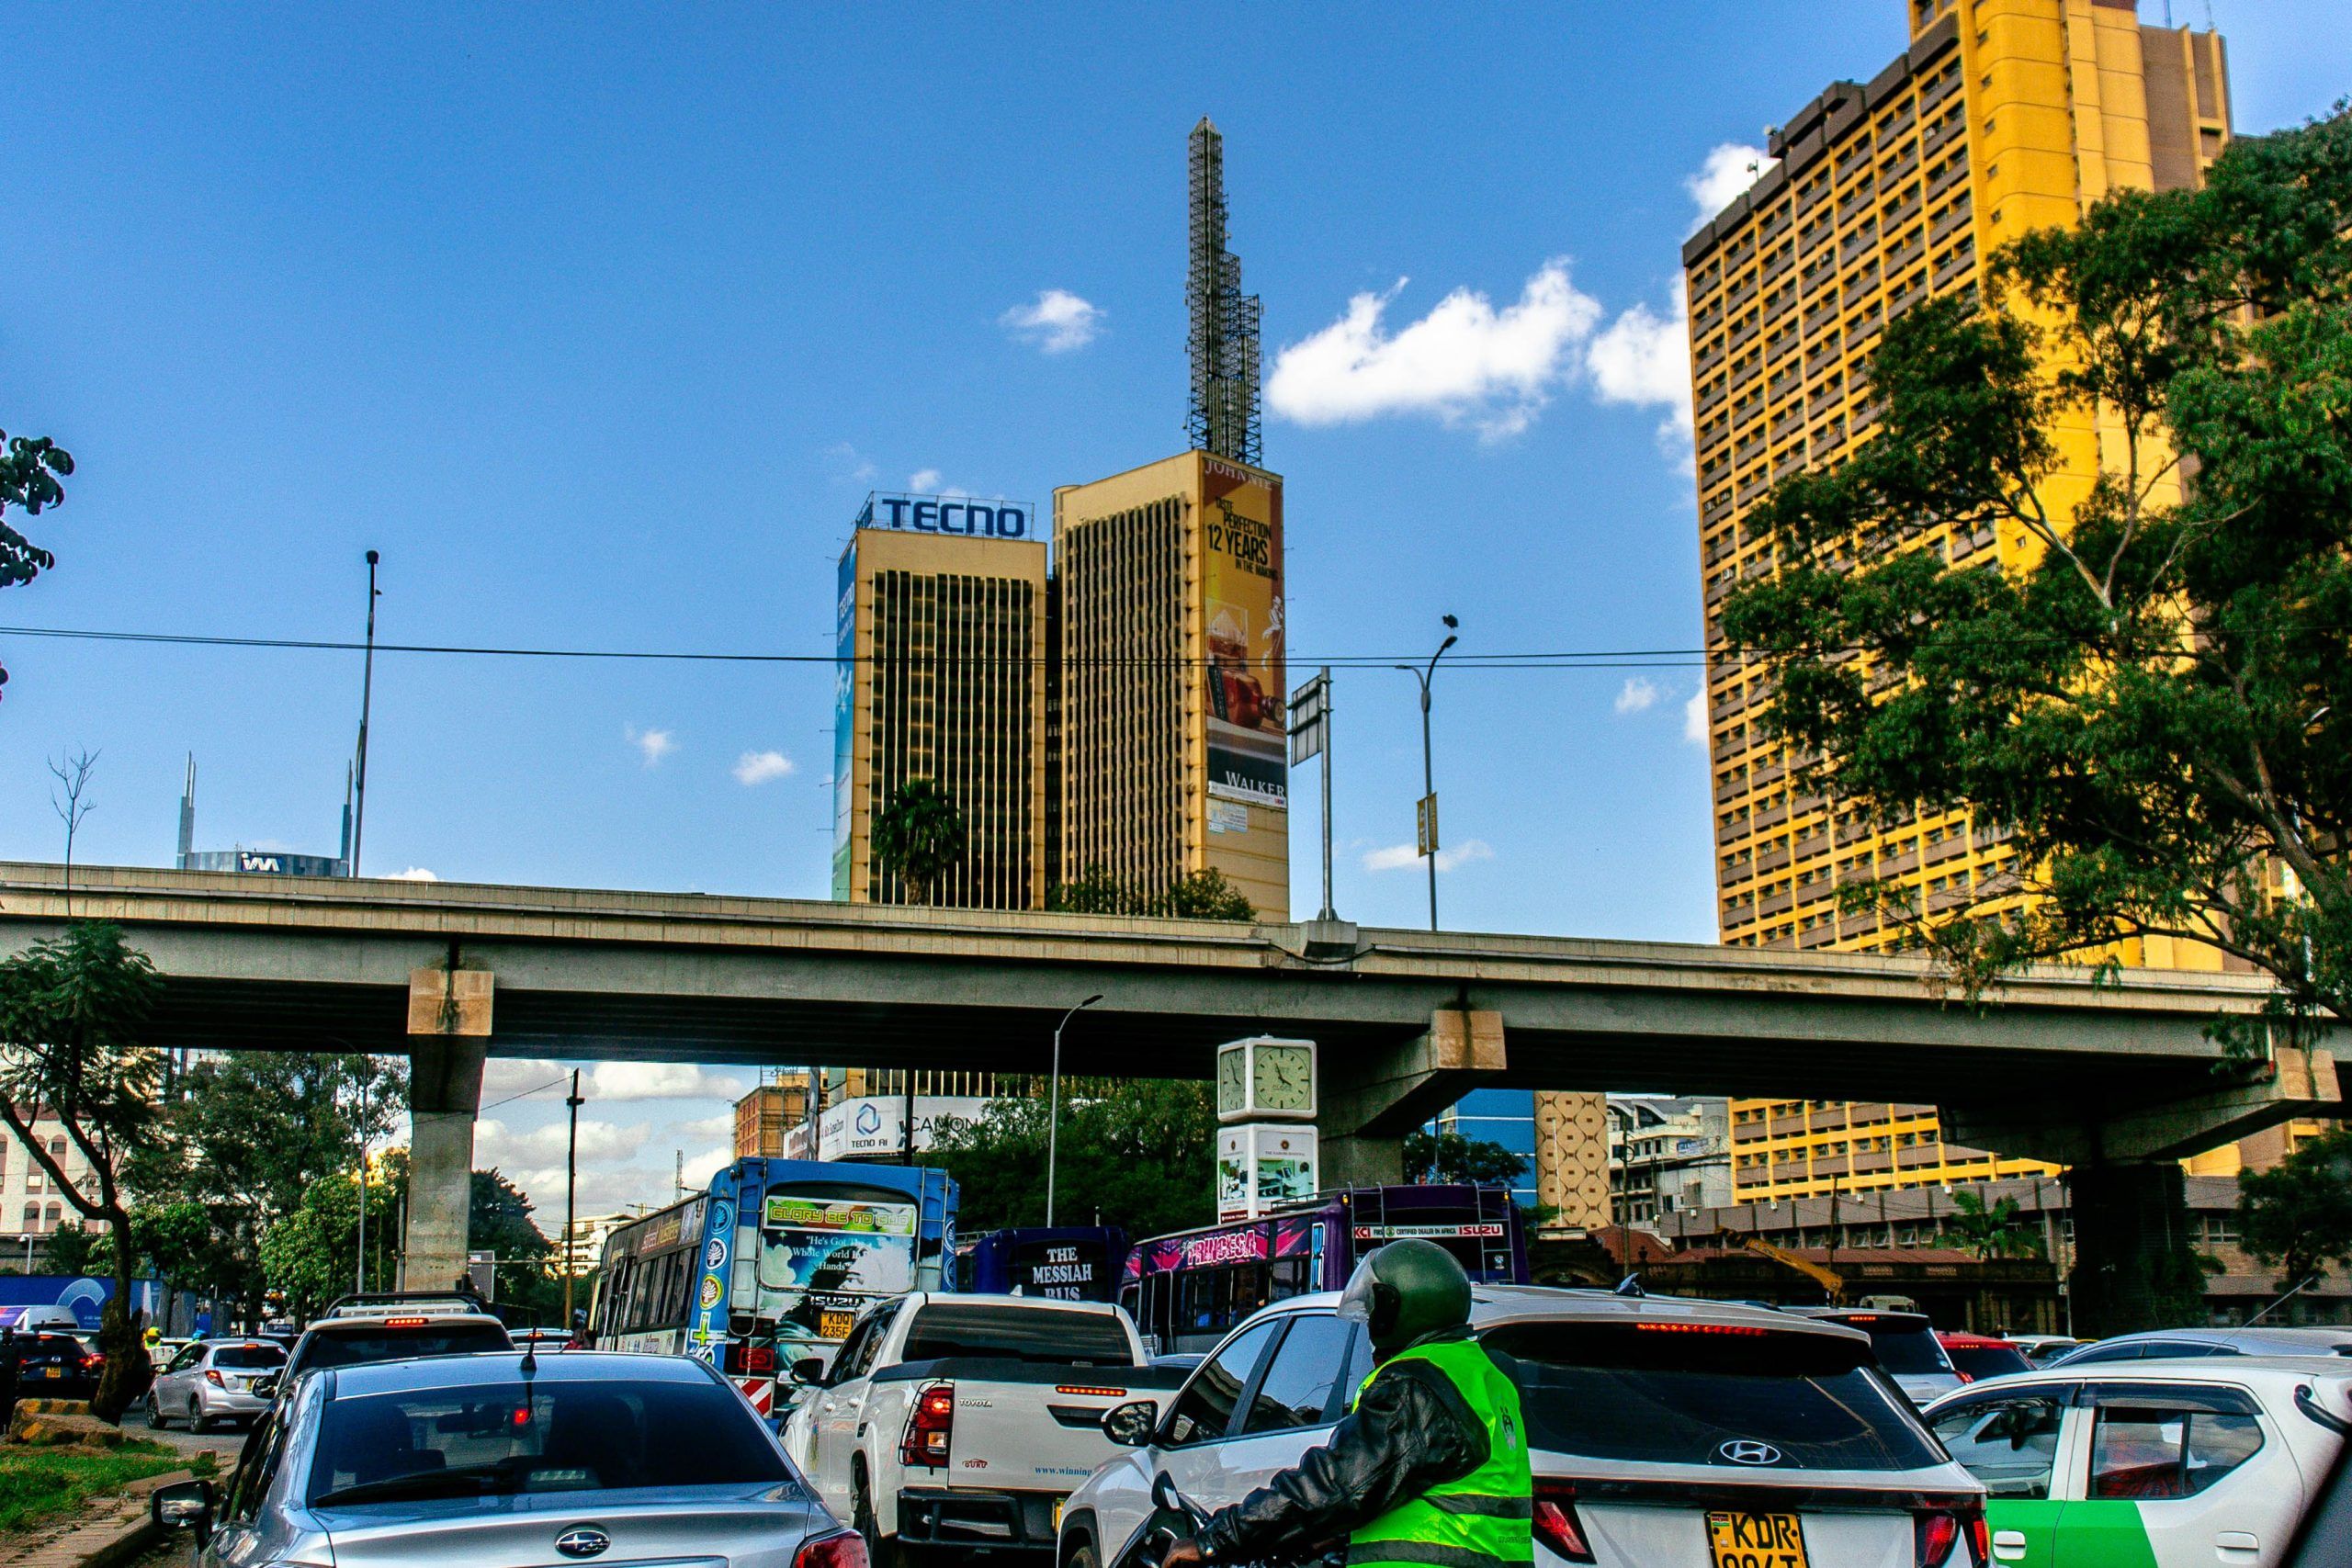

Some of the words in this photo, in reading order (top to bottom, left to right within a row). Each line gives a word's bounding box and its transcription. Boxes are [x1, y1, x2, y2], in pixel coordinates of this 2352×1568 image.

[1204, 461, 1272, 491] JOHNNIE
[882, 498, 1025, 537] TECNO
[1224, 511, 1272, 540] PERFECTION
[1207, 523, 1222, 551] 12
[1225, 528, 1268, 566] YEARS
[1243, 561, 1254, 574] THE
[1226, 771, 1285, 797] WALKER
[911, 1116, 980, 1133] CAMON
[851, 1140, 876, 1148] TECNO
[771, 1206, 824, 1222] GLORY
[825, 1210, 848, 1224] BE
[851, 1212, 874, 1225] TO
[1354, 1226, 1371, 1238] KCI
[1459, 1224, 1500, 1235] ISUZU
[830, 1236, 846, 1247] Got
[1187, 1229, 1256, 1266] PRINCESA
[792, 1247, 820, 1258] Whole
[823, 1248, 850, 1259] World
[1046, 1247, 1078, 1263] THE
[1033, 1264, 1092, 1284] MESSIAH
[810, 1295, 860, 1306] ISUZU
[1045, 1286, 1080, 1302] BUS
[829, 1314, 850, 1325] KDQ
[822, 1325, 849, 1337] 235F
[960, 1398, 992, 1408] TOYOTA
[1731, 1514, 1796, 1550] KDR
